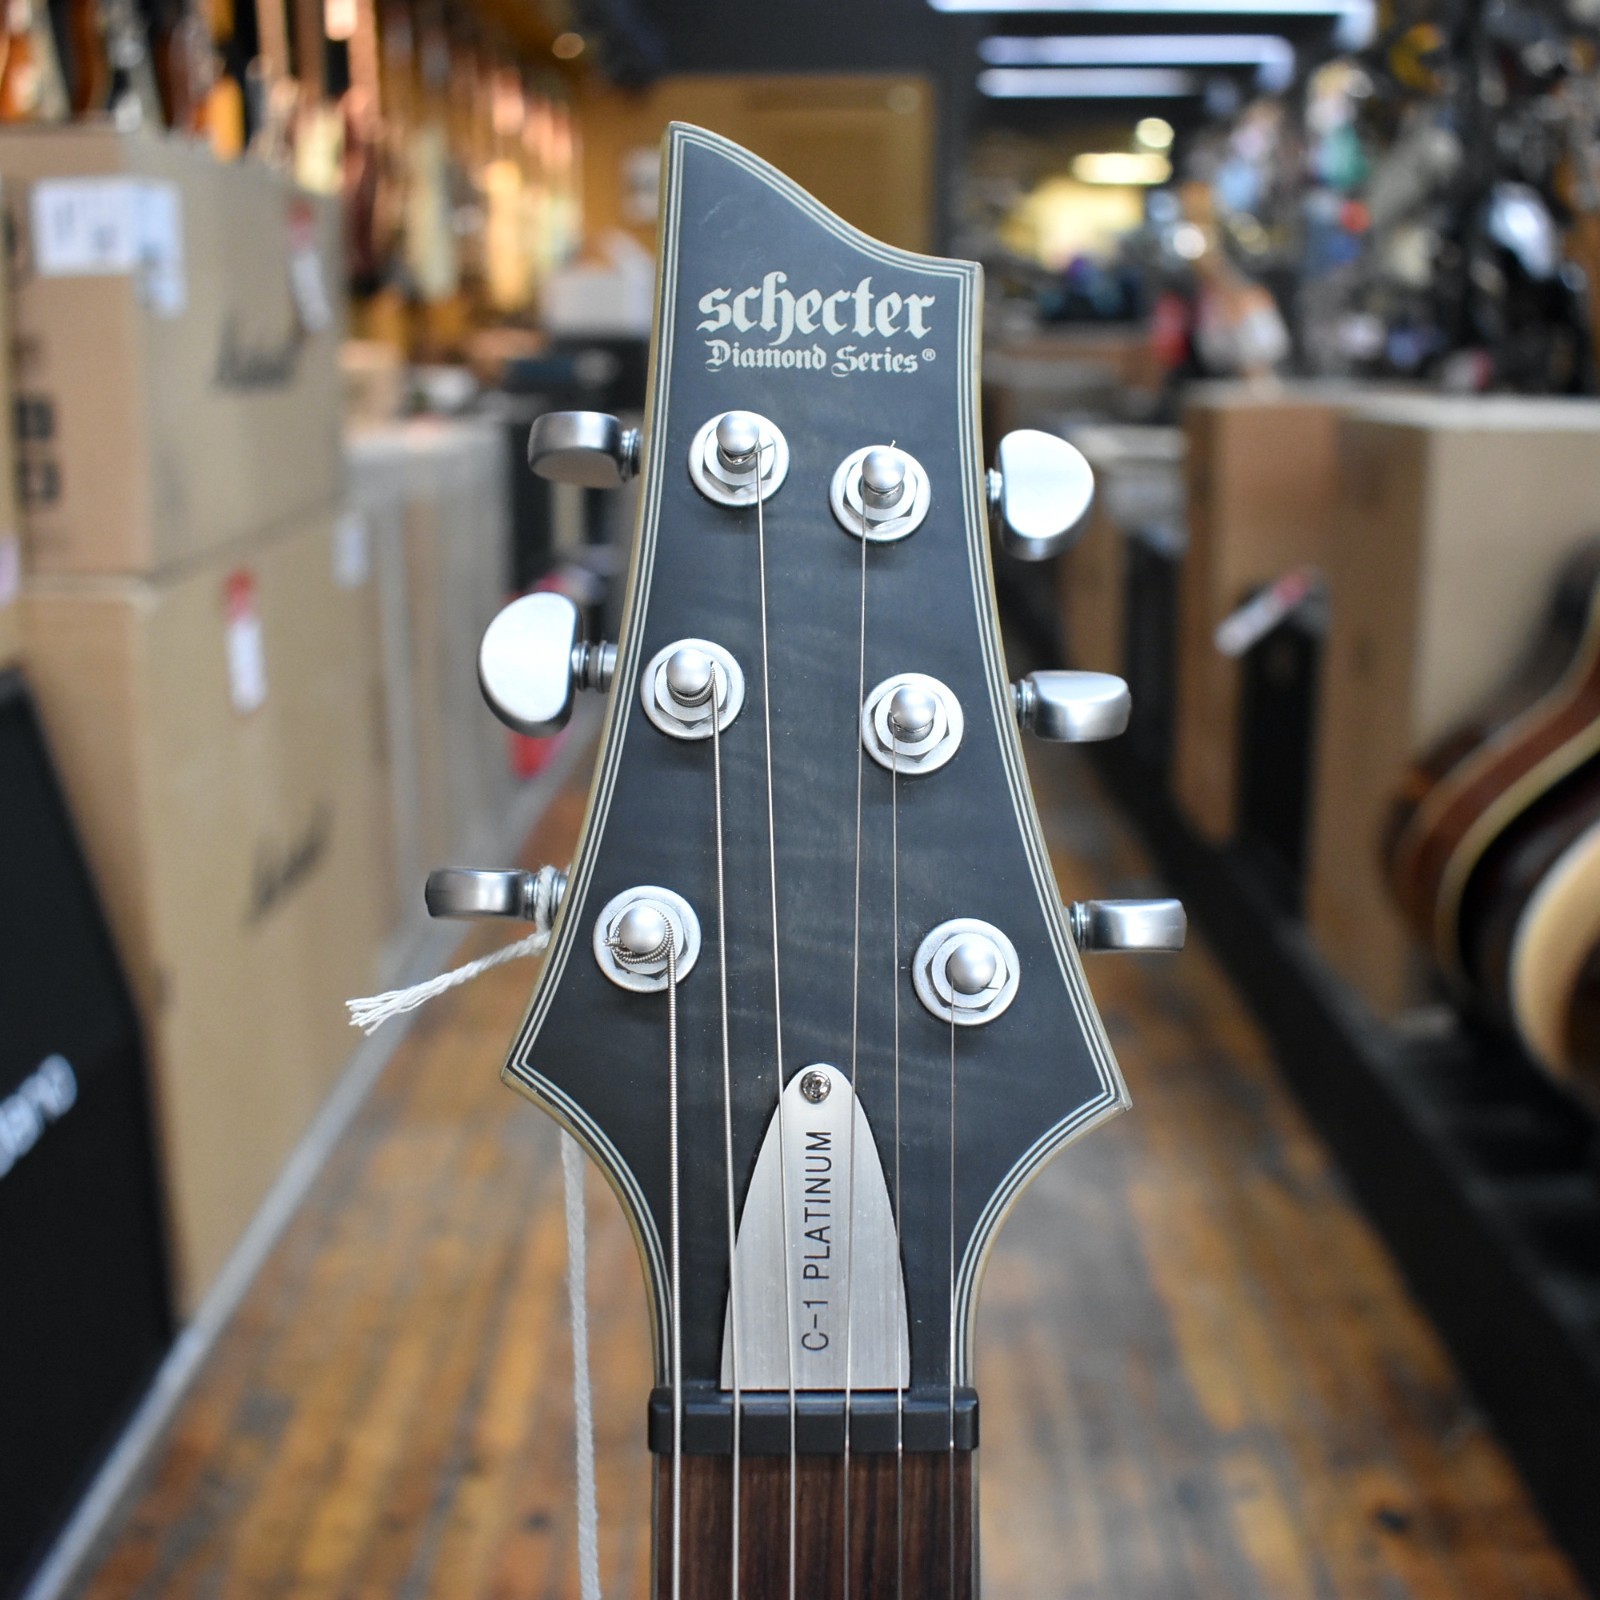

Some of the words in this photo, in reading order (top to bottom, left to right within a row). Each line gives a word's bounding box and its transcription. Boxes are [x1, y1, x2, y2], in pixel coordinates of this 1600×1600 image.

[696, 271, 935, 346] schecter
[705, 339, 826, 372] Diamond
[803, 1131, 832, 1280] PLATINUM
[802, 1300, 829, 1351] C-1
